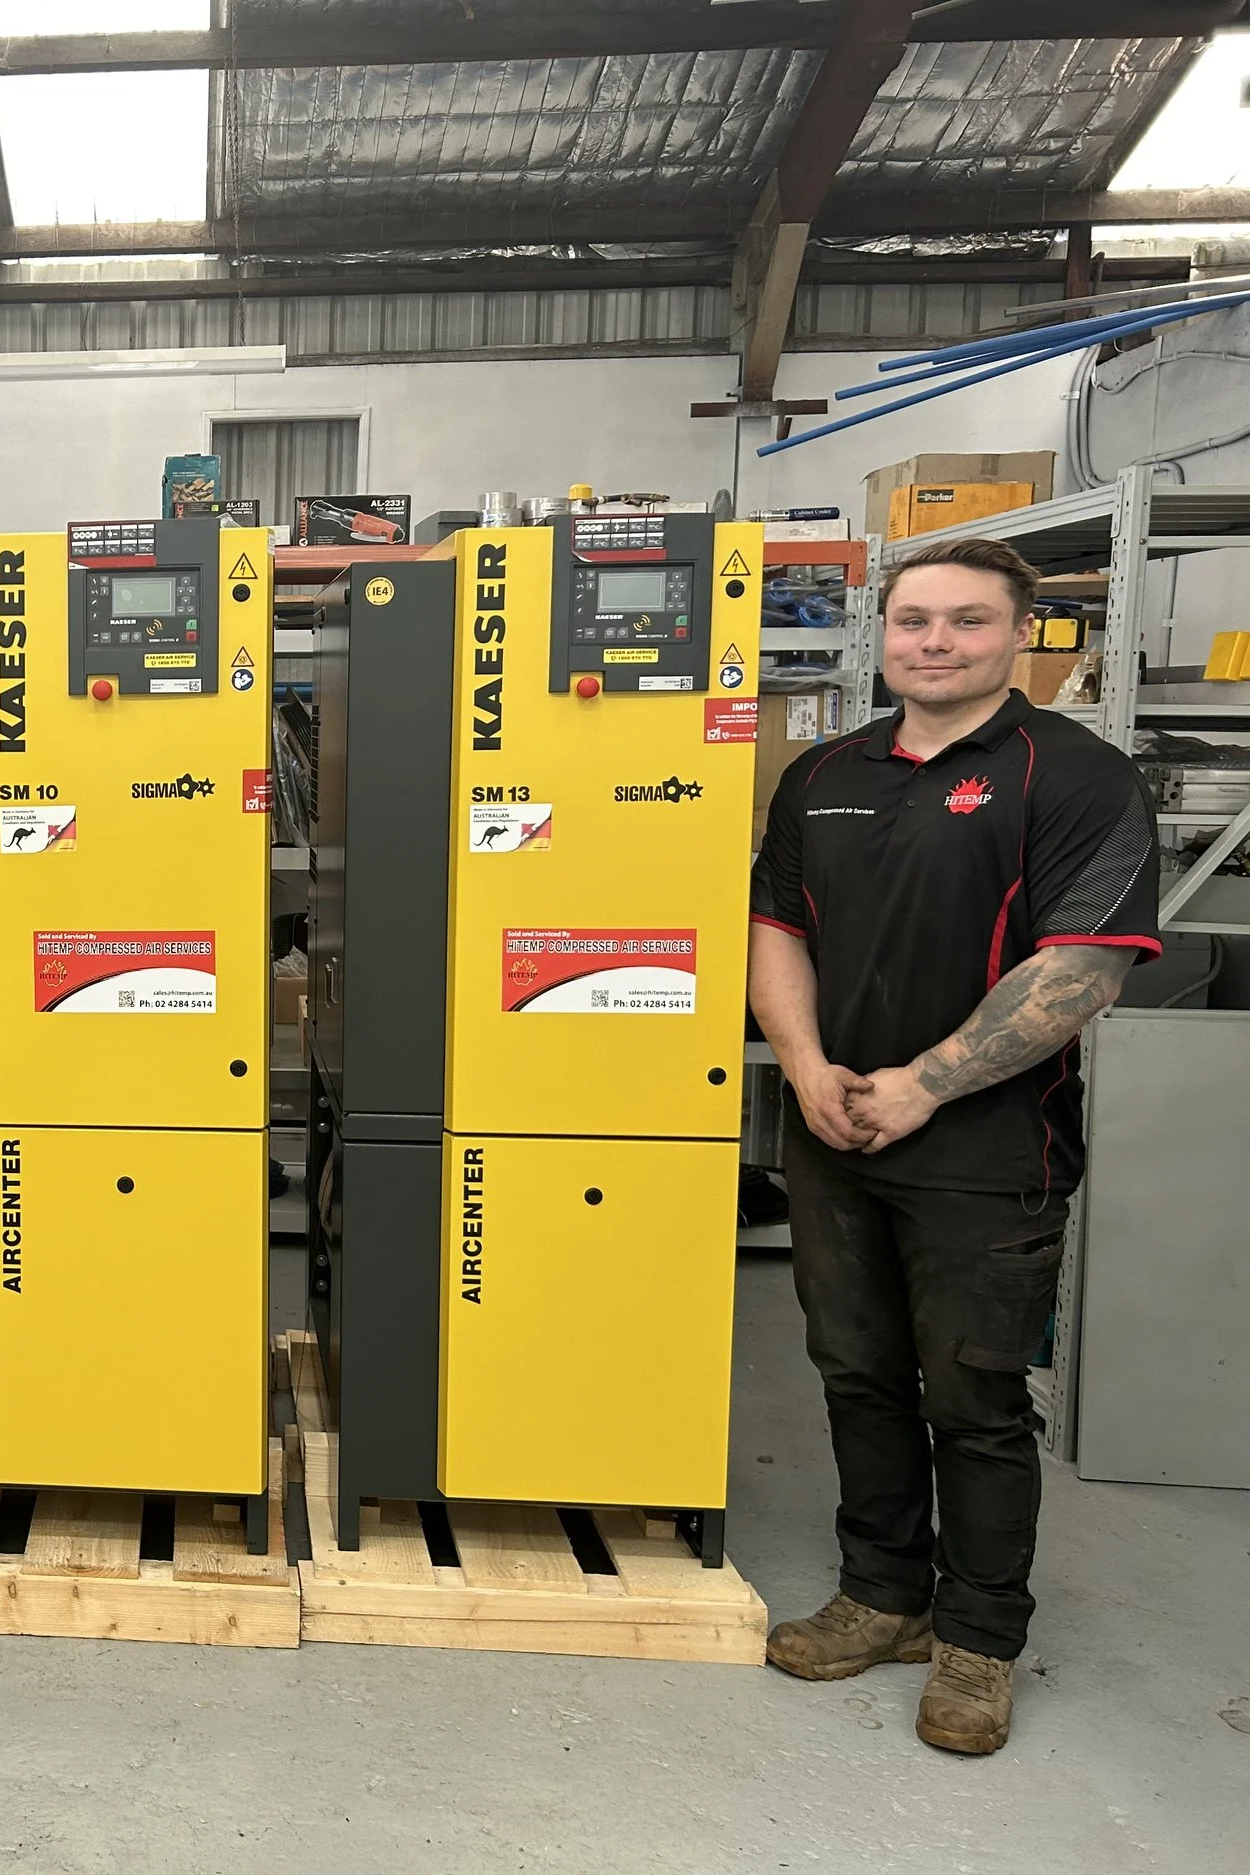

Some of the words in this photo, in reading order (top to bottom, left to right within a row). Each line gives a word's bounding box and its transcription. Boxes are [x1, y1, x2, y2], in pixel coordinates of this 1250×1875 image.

[371, 499, 405, 507] AL-2331
[924, 493, 955, 502] Parker
[300, 500, 308, 538] ALLIANCE
[373, 587, 389, 596] IE4
[473, 543, 507, 751] KAESER
[0, 784, 30, 800] SM
[36, 784, 59, 800] 10
[131, 782, 178, 799] SIGMA
[471, 786, 504, 802] SM
[507, 786, 530, 802] 13
[614, 786, 663, 802] SIGMA
[944, 793, 992, 806] HITEMP
[37, 942, 74, 956] HITEMP
[76, 942, 144, 956] COMPRESSED
[145, 942, 163, 955] AIR
[163, 942, 211, 955] SERVICES
[507, 940, 546, 954] HITEMP
[546, 940, 620, 954] COMPRESSED
[621, 940, 640, 953] AIR
[641, 940, 693, 953] SERVICES
[139, 1000, 154, 1008] Ph:
[155, 1000, 167, 1008] 02
[167, 1000, 189, 1008] 4284
[191, 1000, 213, 1008] 5414
[613, 1000, 629, 1008] Ph:
[630, 1000, 642, 1008] 02
[643, 1000, 667, 1008] 4284
[668, 1000, 692, 1008] 5414
[1, 1139, 22, 1294] AIRCENTER
[461, 1148, 484, 1305] AIRCENTER
